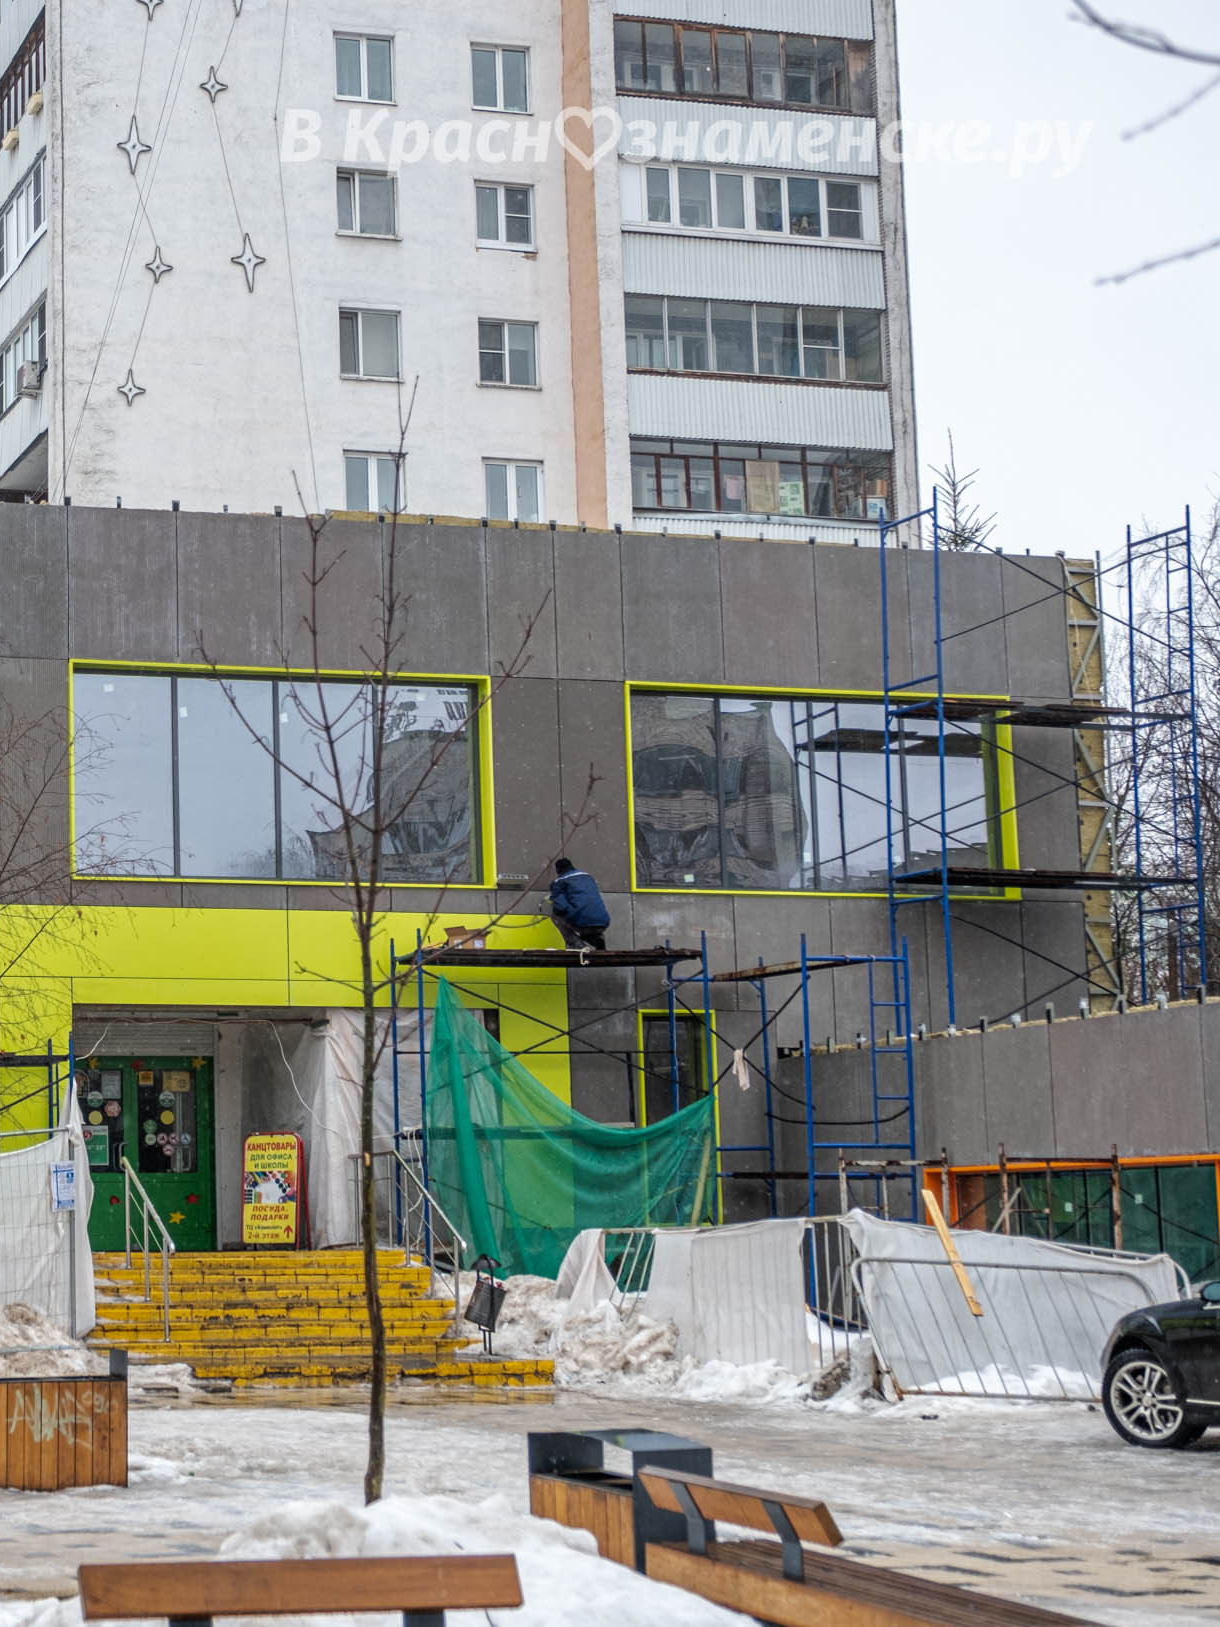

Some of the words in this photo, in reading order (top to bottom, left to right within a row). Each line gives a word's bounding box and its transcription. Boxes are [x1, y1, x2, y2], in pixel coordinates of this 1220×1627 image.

[247, 1142, 296, 1152] КАНЦТОВАРЫ
[250, 1154, 265, 1162] ДЛЯ
[250, 1213, 289, 1221] ПОДАРКИ
